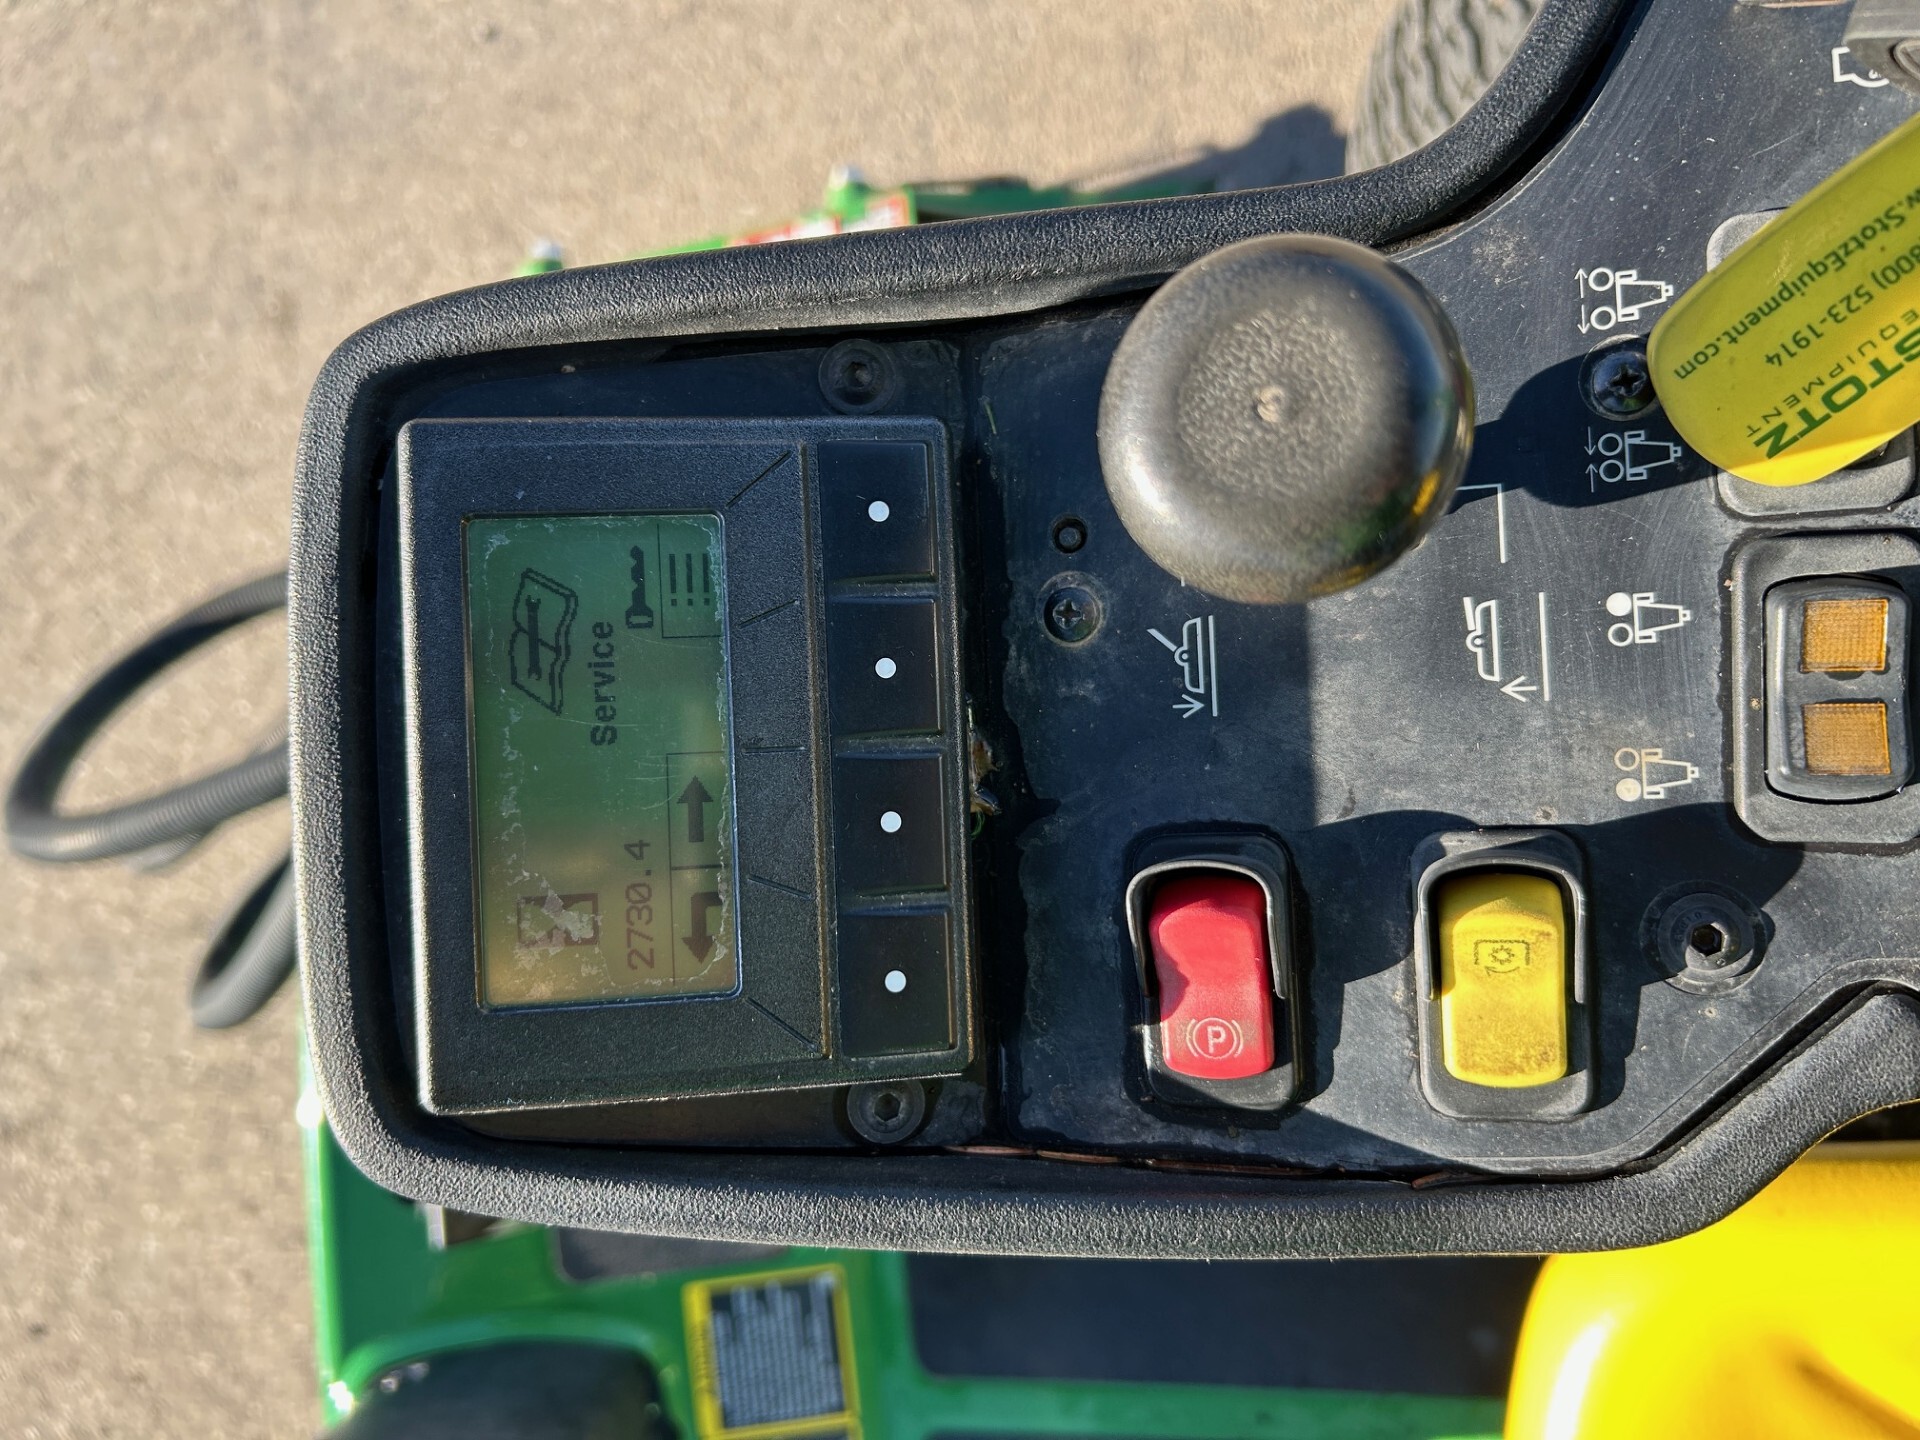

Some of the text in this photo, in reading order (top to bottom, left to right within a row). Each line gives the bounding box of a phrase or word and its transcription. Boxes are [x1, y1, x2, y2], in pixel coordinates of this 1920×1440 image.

[1746, 308, 1919, 438] EQUIPMENT
[1764, 284, 1874, 367] 523-1914
[1753, 327, 1920, 459] STOTZ
[587, 620, 618, 747] Service
[623, 839, 655, 972] 2730.4
[1206, 1025, 1227, 1055] P
